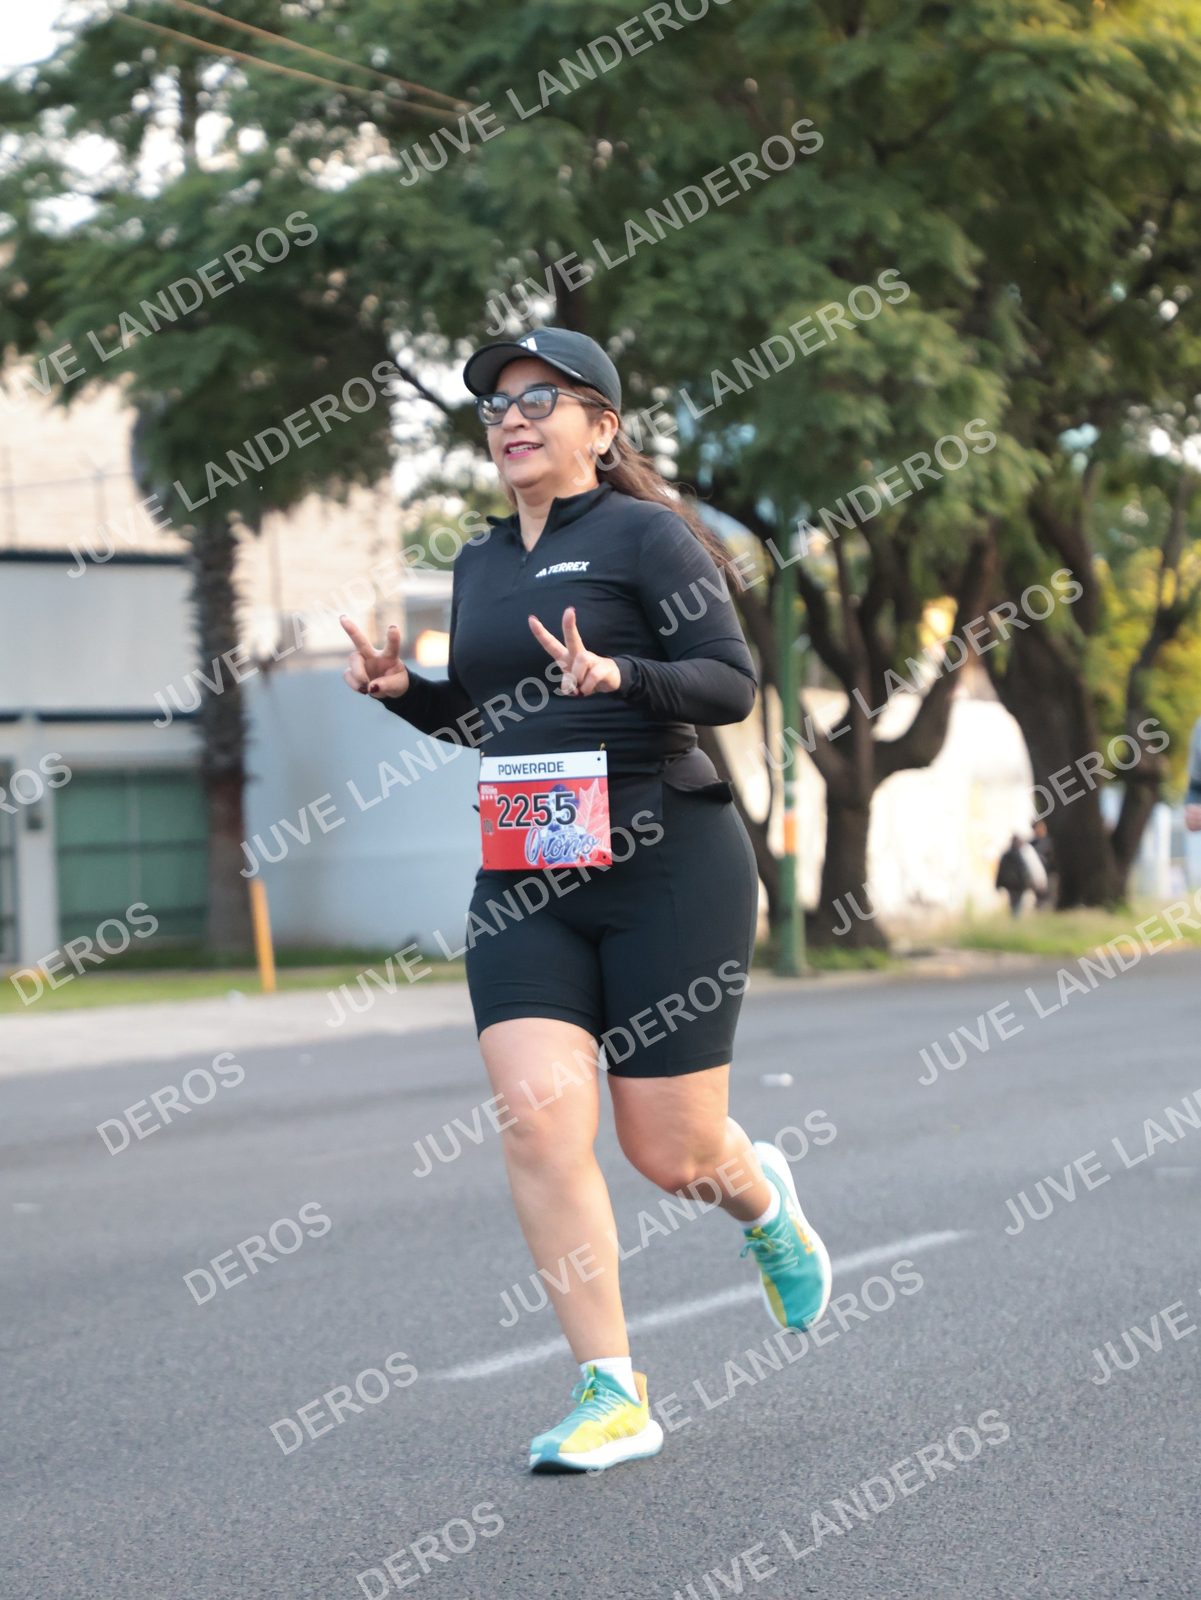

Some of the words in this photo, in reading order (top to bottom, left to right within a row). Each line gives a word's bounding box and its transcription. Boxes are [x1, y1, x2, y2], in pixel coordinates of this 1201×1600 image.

[548, 560, 590, 573] TERREX
[498, 761, 564, 775] POWERADE
[497, 792, 577, 828] 2255
